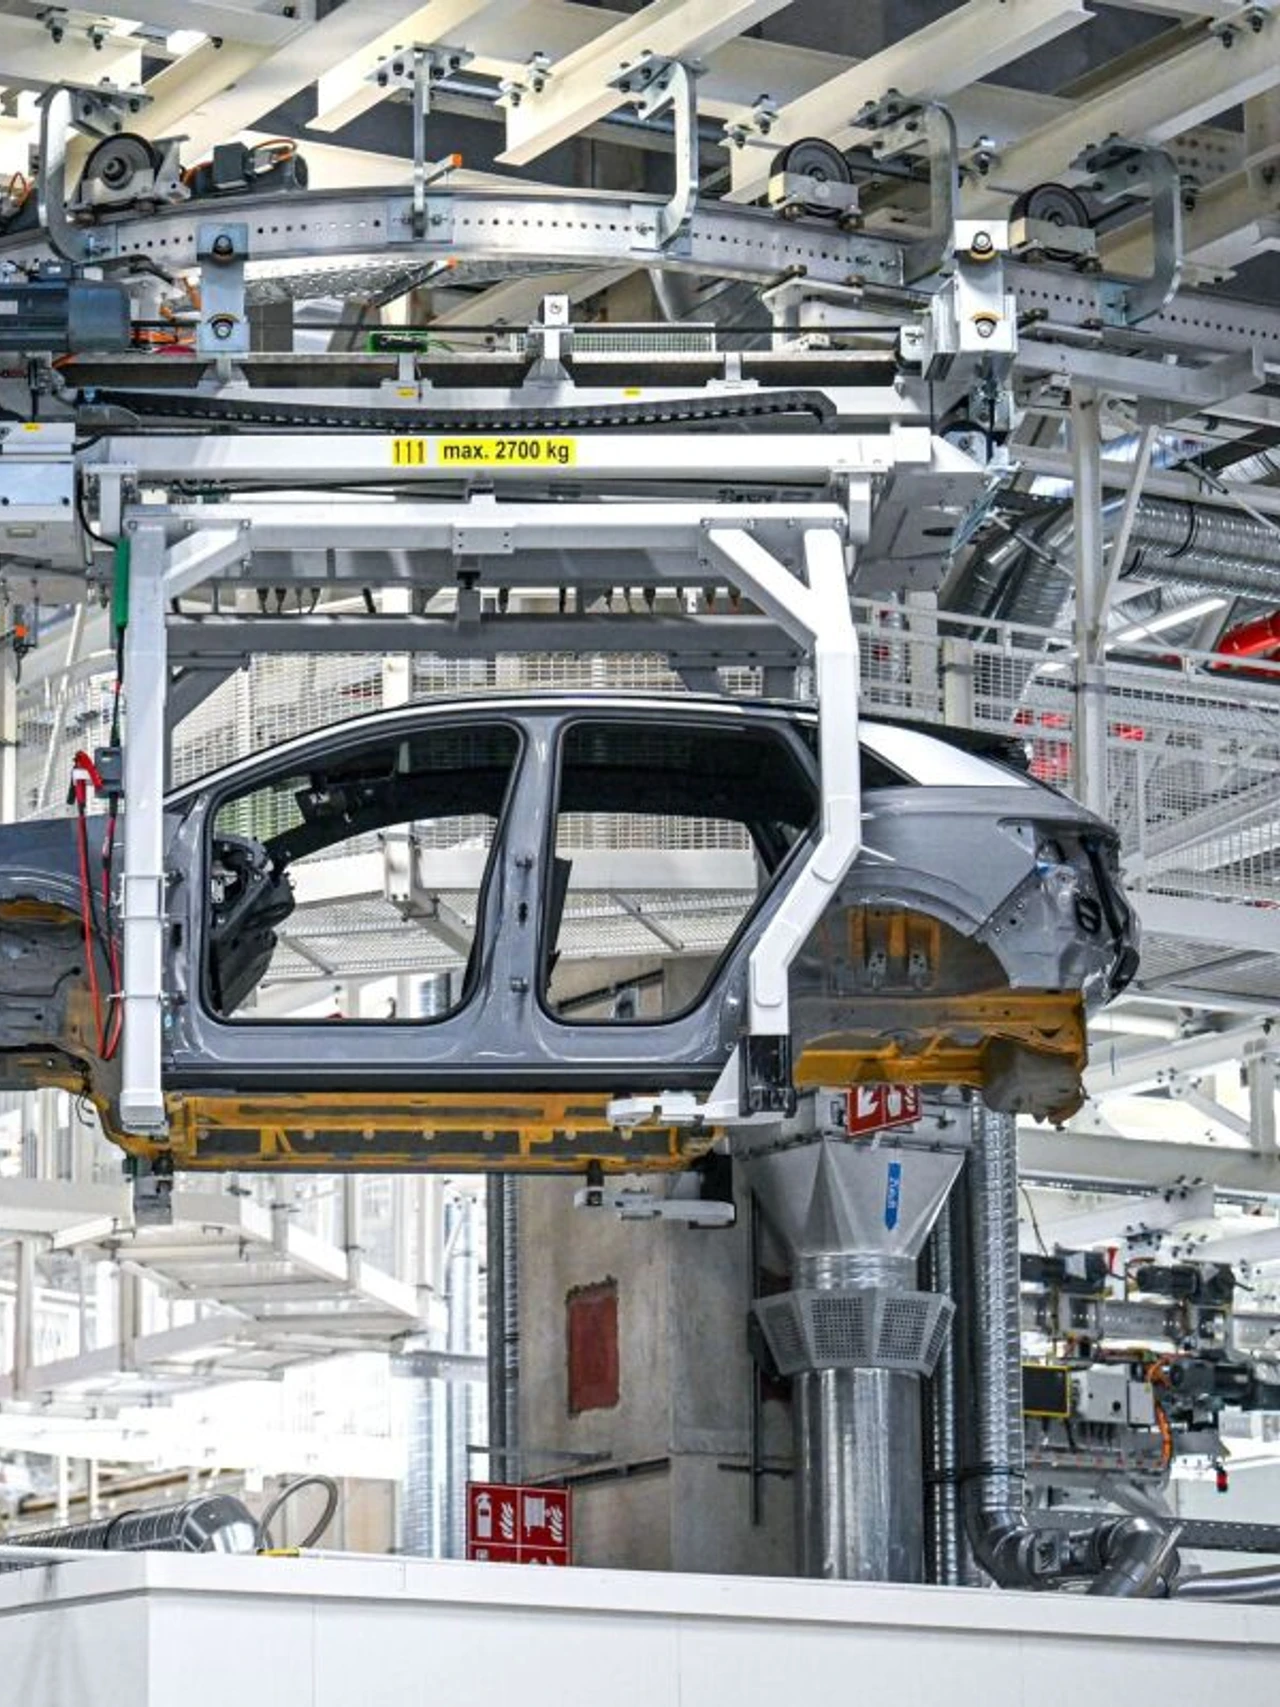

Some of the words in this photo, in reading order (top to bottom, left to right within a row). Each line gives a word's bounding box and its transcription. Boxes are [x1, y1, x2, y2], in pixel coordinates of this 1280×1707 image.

[394, 440, 425, 464] 111
[443, 444, 489, 460] max.
[495, 441, 541, 460] 2700
[547, 441, 569, 464] kg
